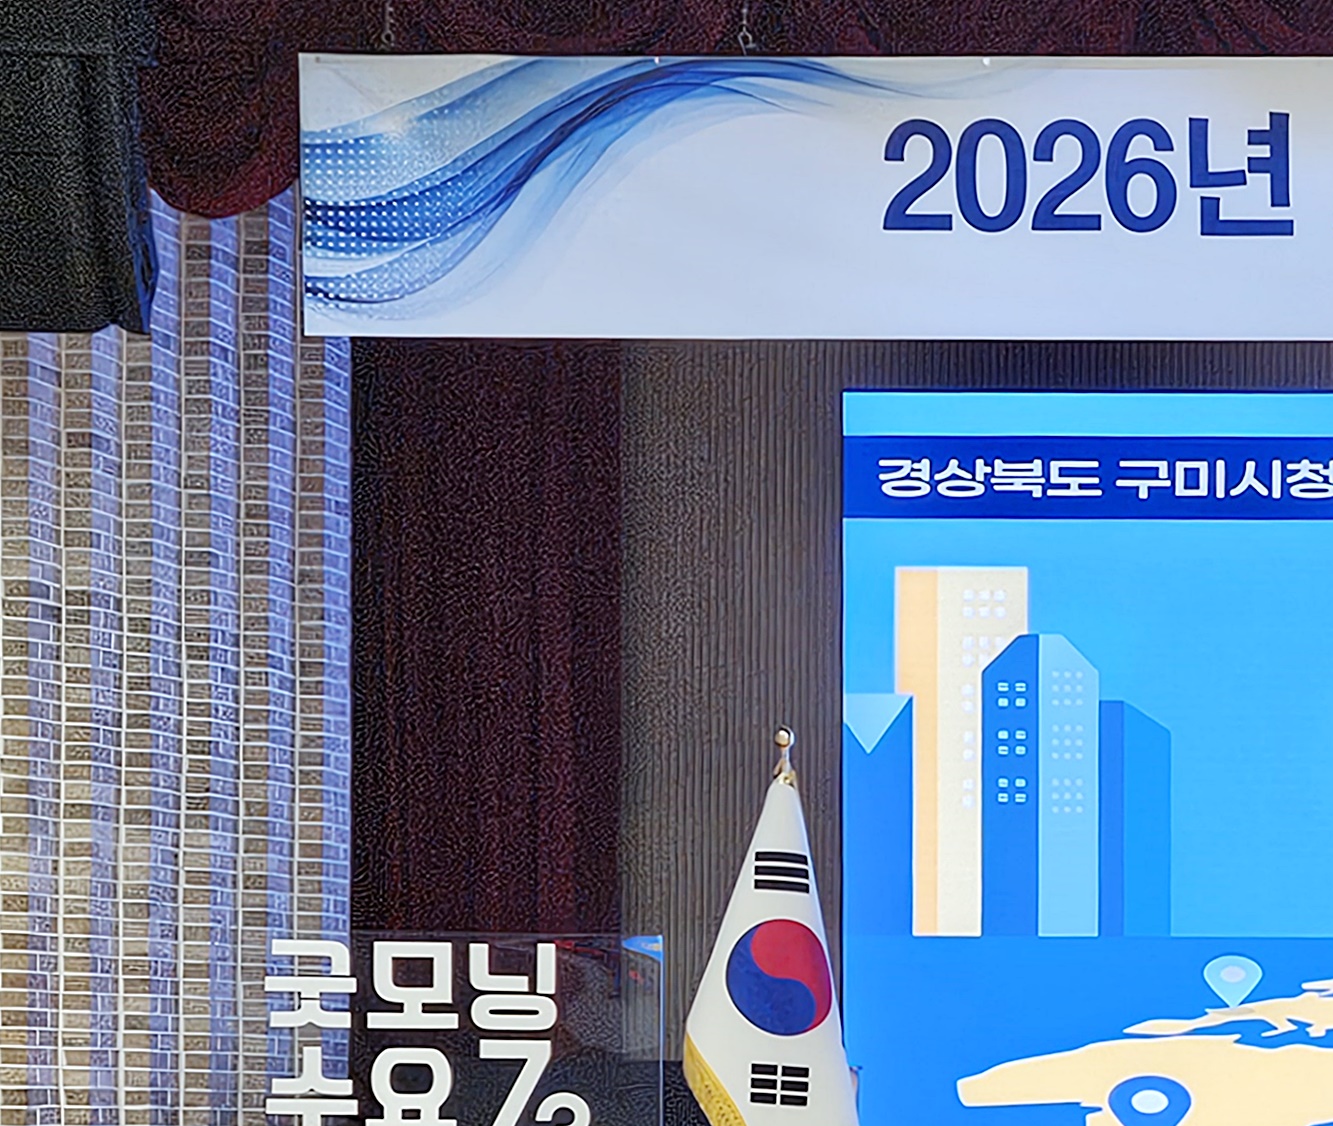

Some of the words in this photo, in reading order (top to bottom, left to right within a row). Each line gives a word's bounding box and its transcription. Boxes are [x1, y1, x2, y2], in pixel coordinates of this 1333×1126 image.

[882, 111, 1295, 237] 2026년
[878, 457, 1103, 499] 경상북도
[265, 939, 557, 1031] 굿모닝
